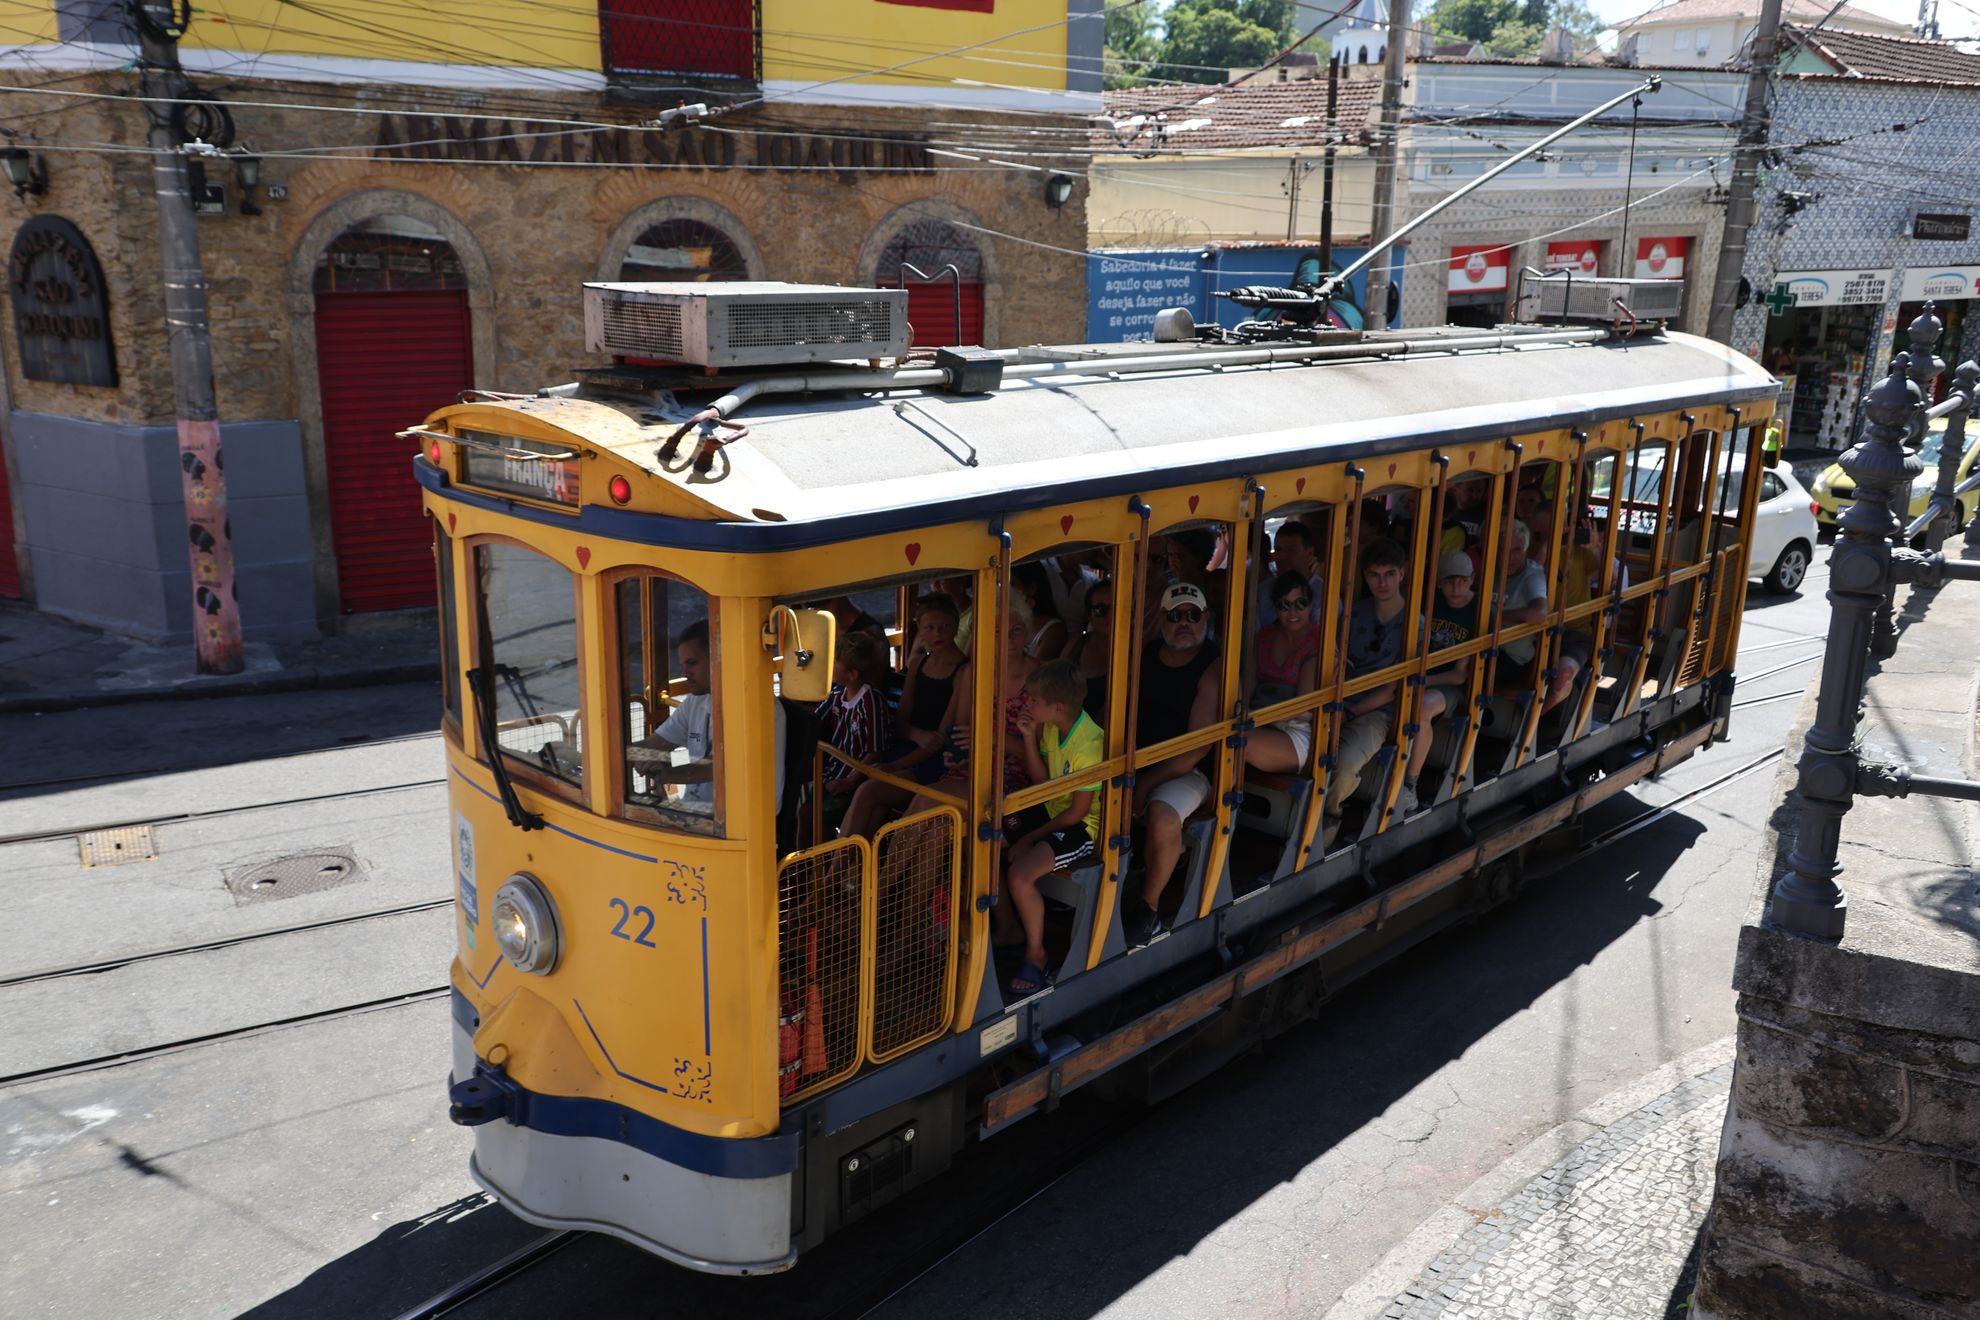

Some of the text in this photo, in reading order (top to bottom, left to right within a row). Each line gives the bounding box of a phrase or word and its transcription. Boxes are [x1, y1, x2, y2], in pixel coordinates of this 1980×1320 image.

[747, 130, 937, 181] JOAQUIM
[1100, 259, 1157, 273] Sabedoria
[1169, 258, 1197, 272] fazer
[1105, 276, 1191, 293] aquilo que você
[1098, 293, 1197, 311] deseja fazer e não
[19, 312, 100, 341] JOAQUIM
[1109, 316, 1122, 327] se
[504, 459, 566, 498] FRANÇA
[608, 897, 657, 948] 22
